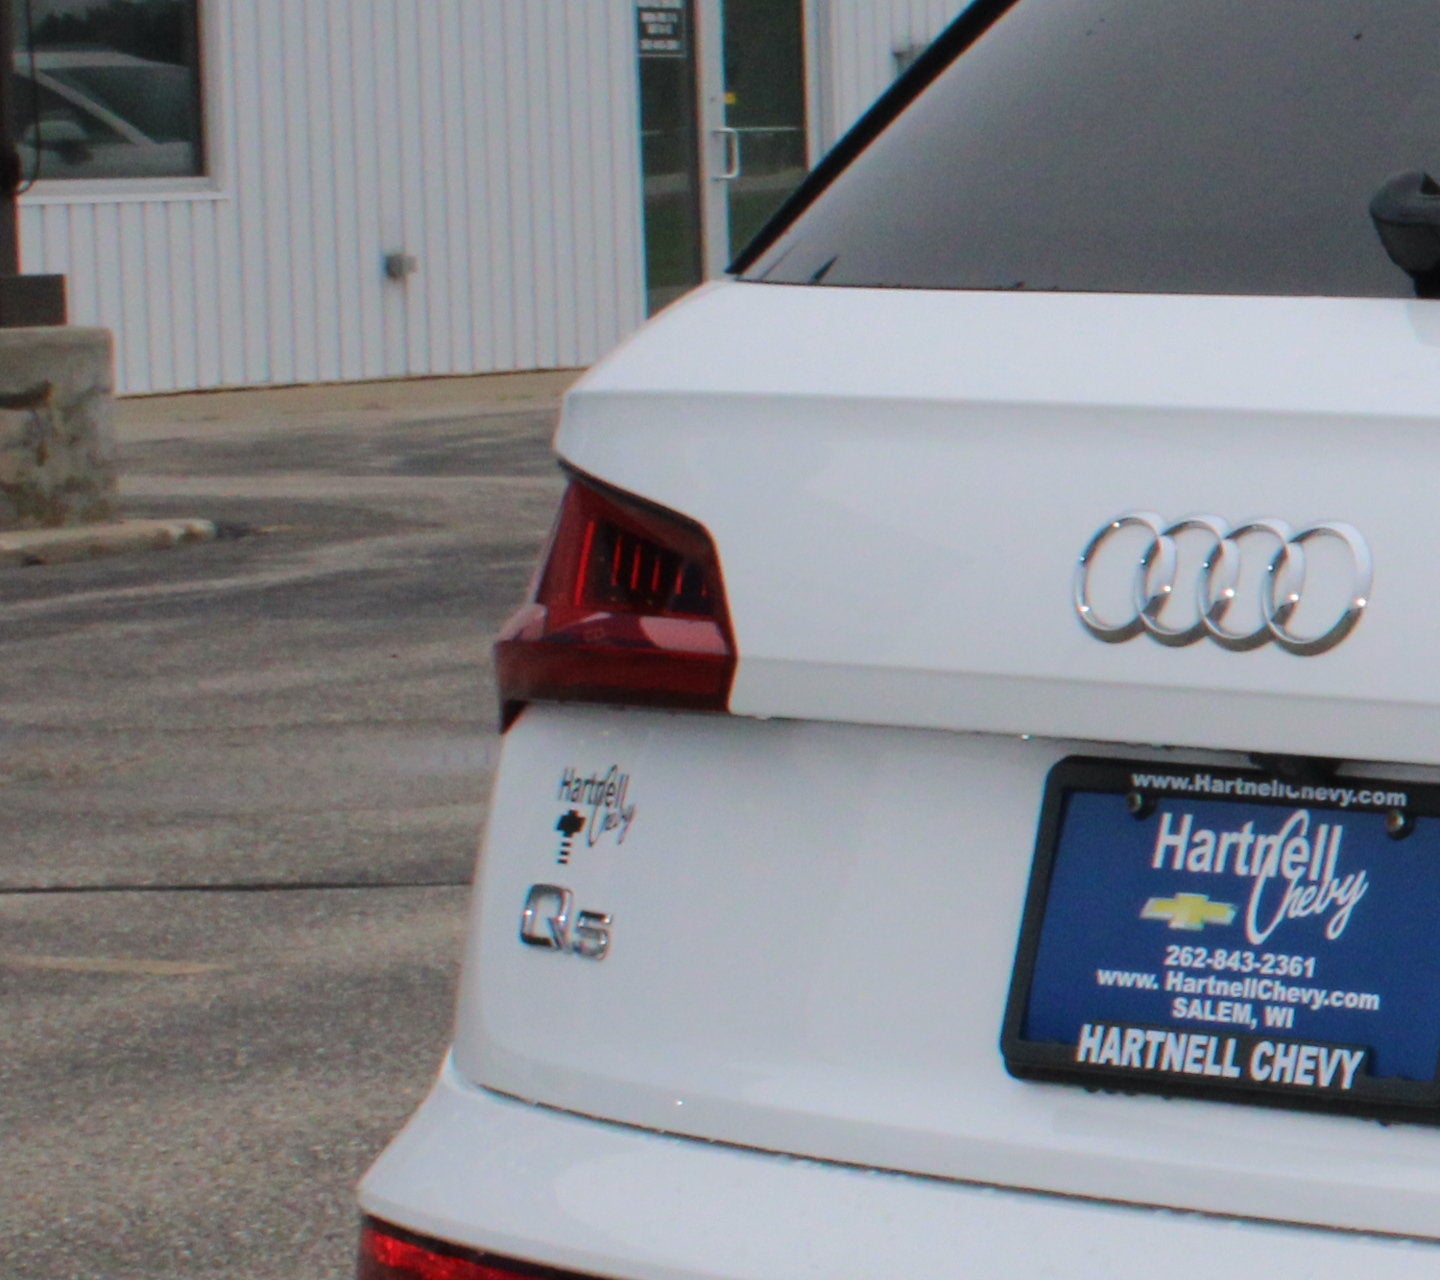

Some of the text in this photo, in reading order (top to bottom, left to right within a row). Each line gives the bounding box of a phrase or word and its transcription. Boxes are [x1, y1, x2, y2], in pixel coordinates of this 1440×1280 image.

[1152, 812, 1343, 882] Hartnell
[1246, 810, 1369, 946] Chevy
[520, 883, 613, 960] Q5
[1165, 945, 1315, 978] 262-843-2361
[1172, 997, 1294, 1029] SALEM, WI
[1076, 1024, 1364, 1090] HARTNELL CHEVY
